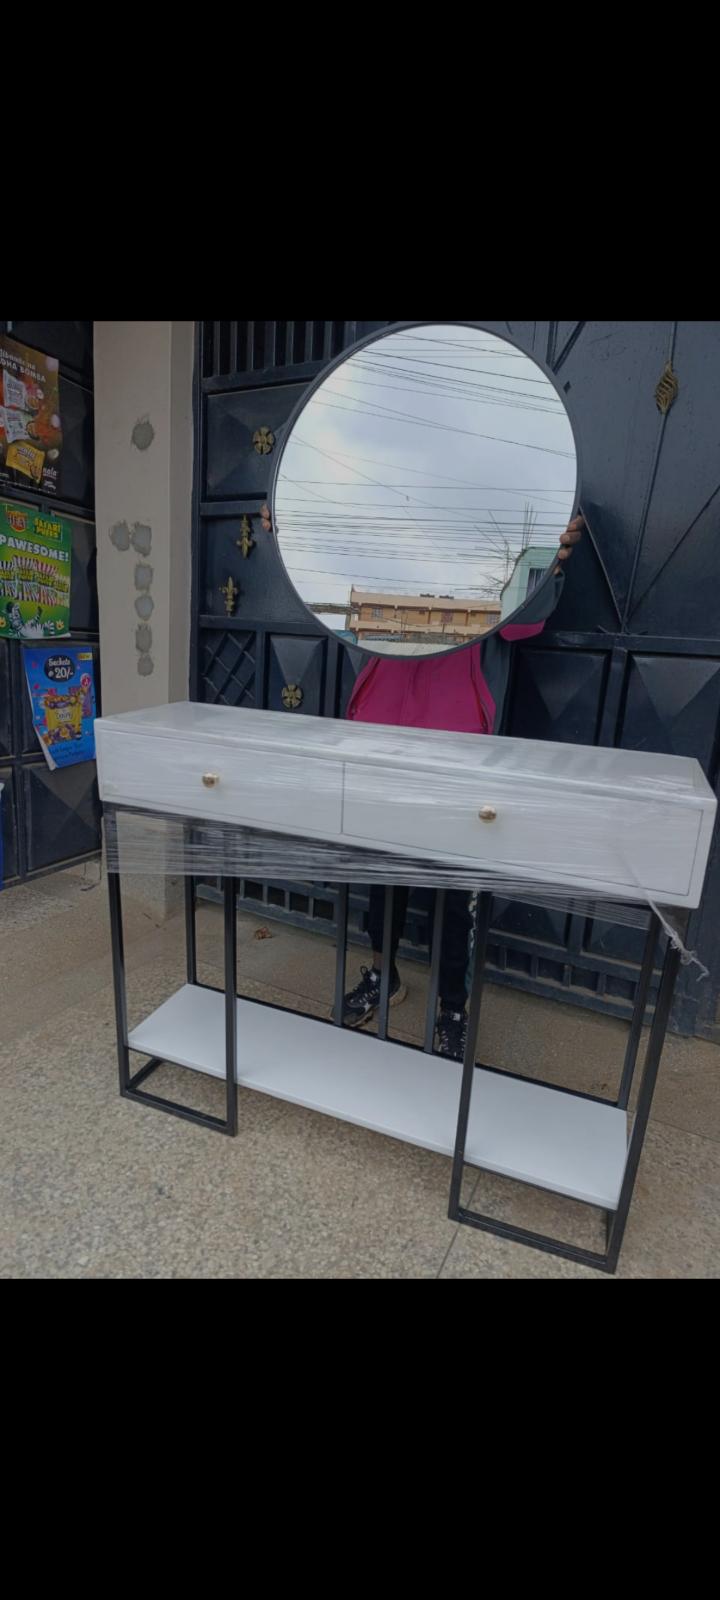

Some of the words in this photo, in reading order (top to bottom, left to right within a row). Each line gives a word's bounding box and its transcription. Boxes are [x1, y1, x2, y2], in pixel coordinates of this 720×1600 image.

[20, 365, 46, 383] BOMBA
[0, 534, 69, 561] PAWESOME!
[48, 657, 71, 666] Sachets
